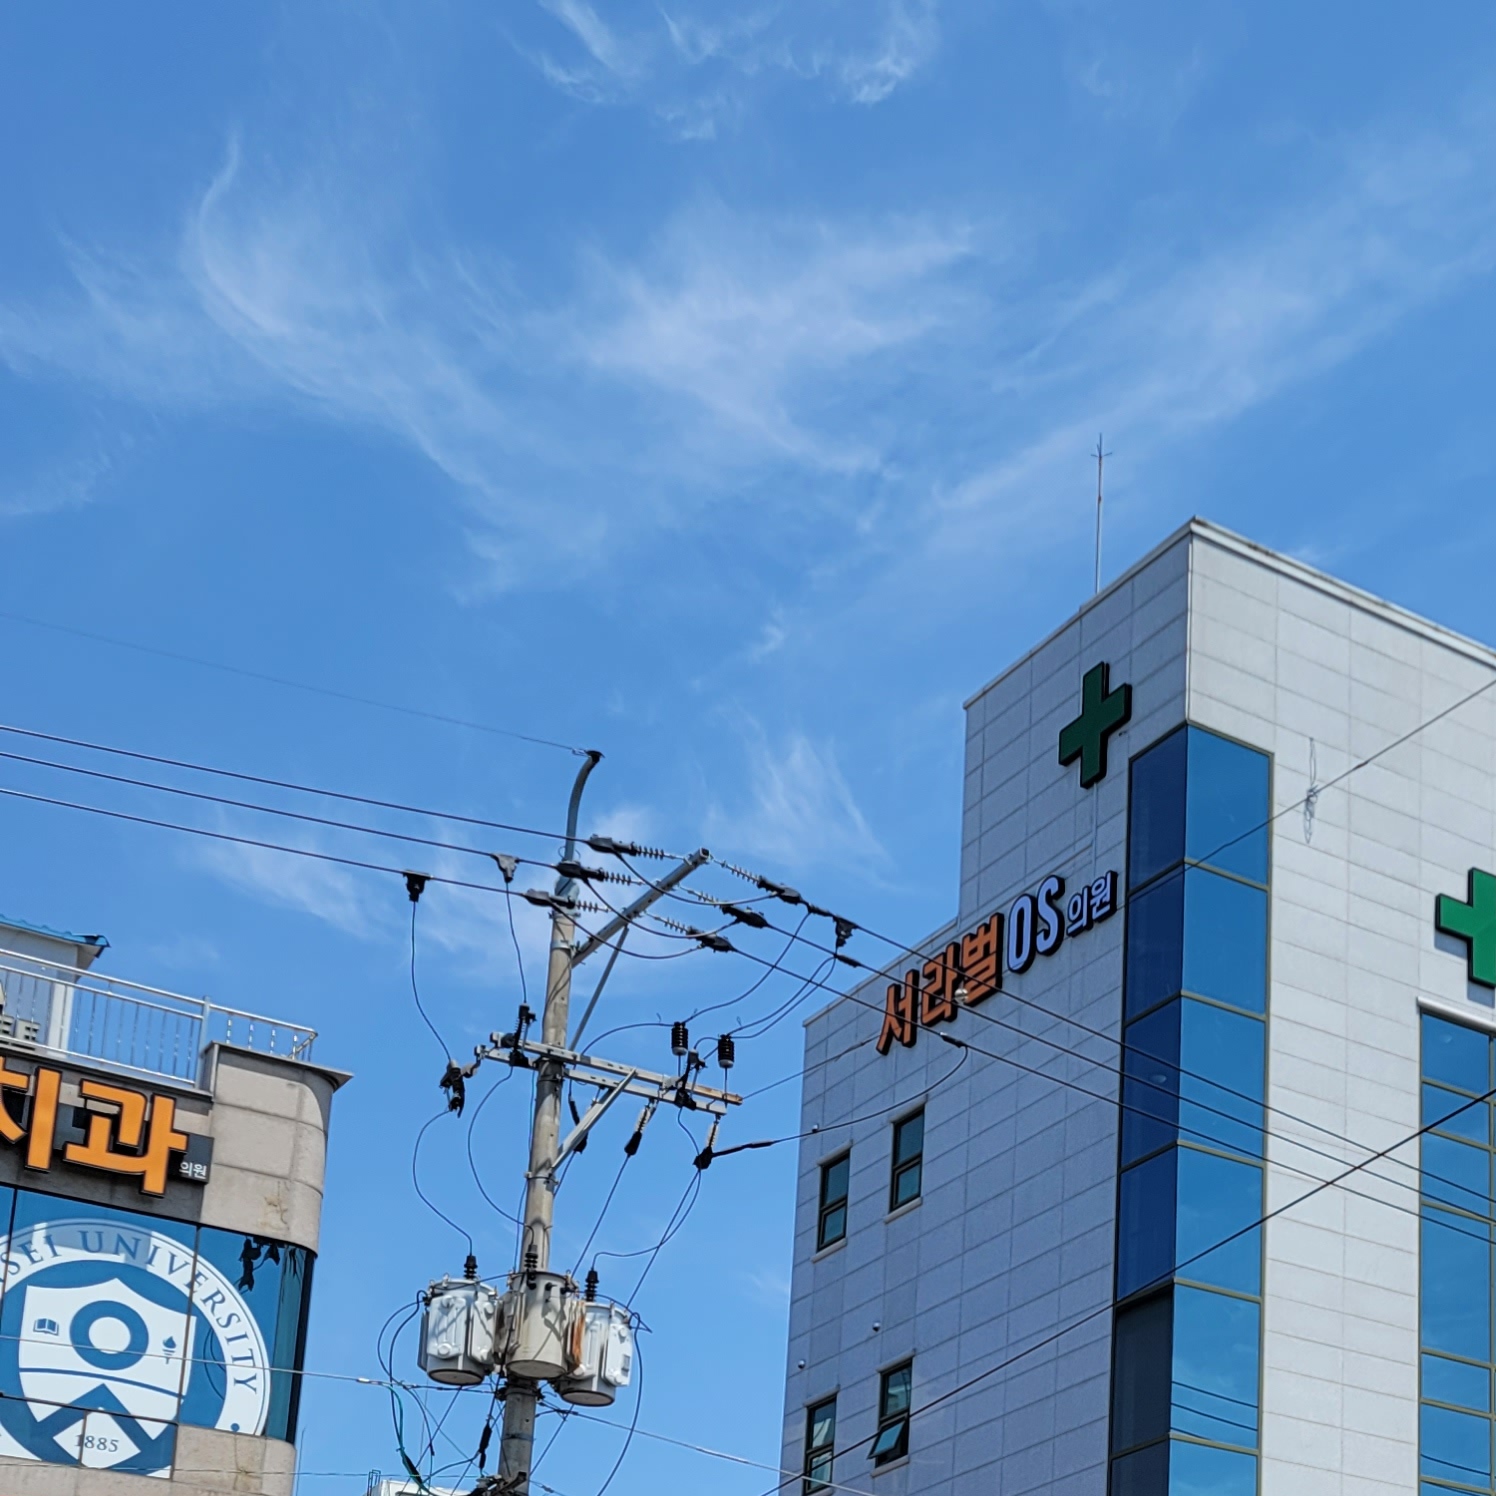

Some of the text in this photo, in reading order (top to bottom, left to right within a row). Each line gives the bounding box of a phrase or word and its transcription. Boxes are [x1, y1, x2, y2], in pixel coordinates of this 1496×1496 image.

[1067, 870, 1118, 937] 의원
[179, 1160, 207, 1180] 의원
[0, 1230, 259, 1395] SEI UNIVERSITY
[74, 1433, 119, 1453] 1885
